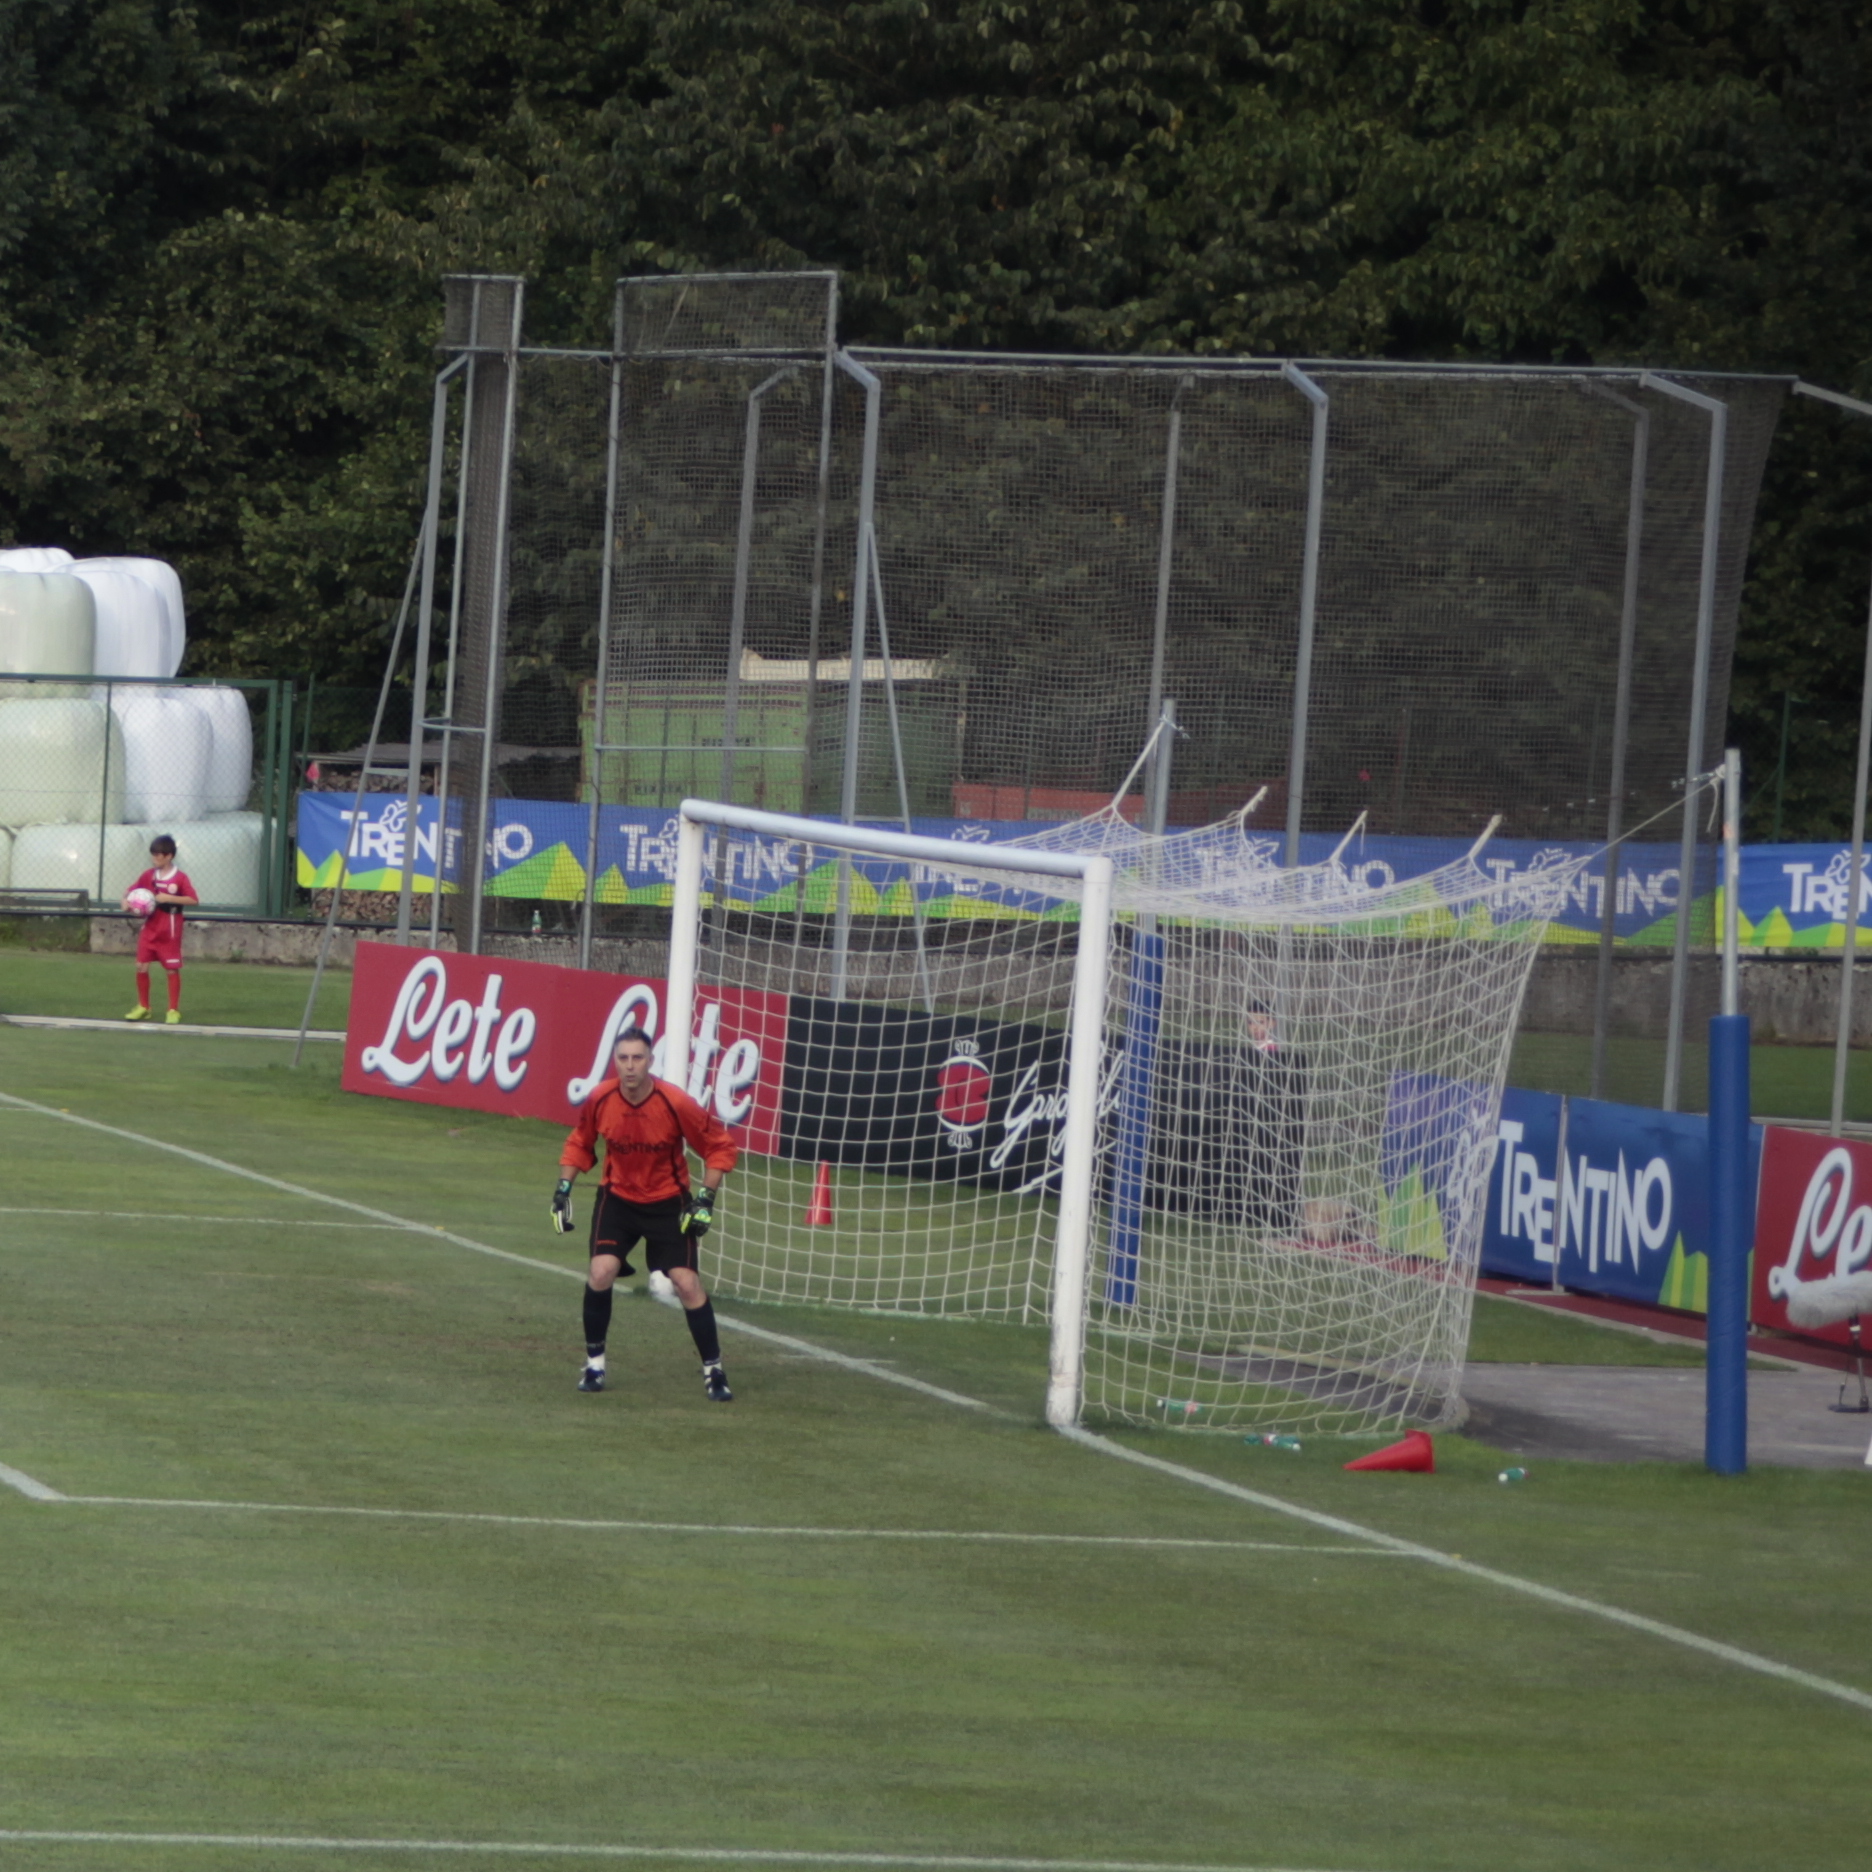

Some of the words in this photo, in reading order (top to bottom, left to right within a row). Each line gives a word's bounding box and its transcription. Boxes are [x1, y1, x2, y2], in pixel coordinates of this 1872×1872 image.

[341, 811, 534, 870] TRENTO
[360, 954, 538, 1093] Lete
[1498, 1119, 1672, 1276] TRENTINO
